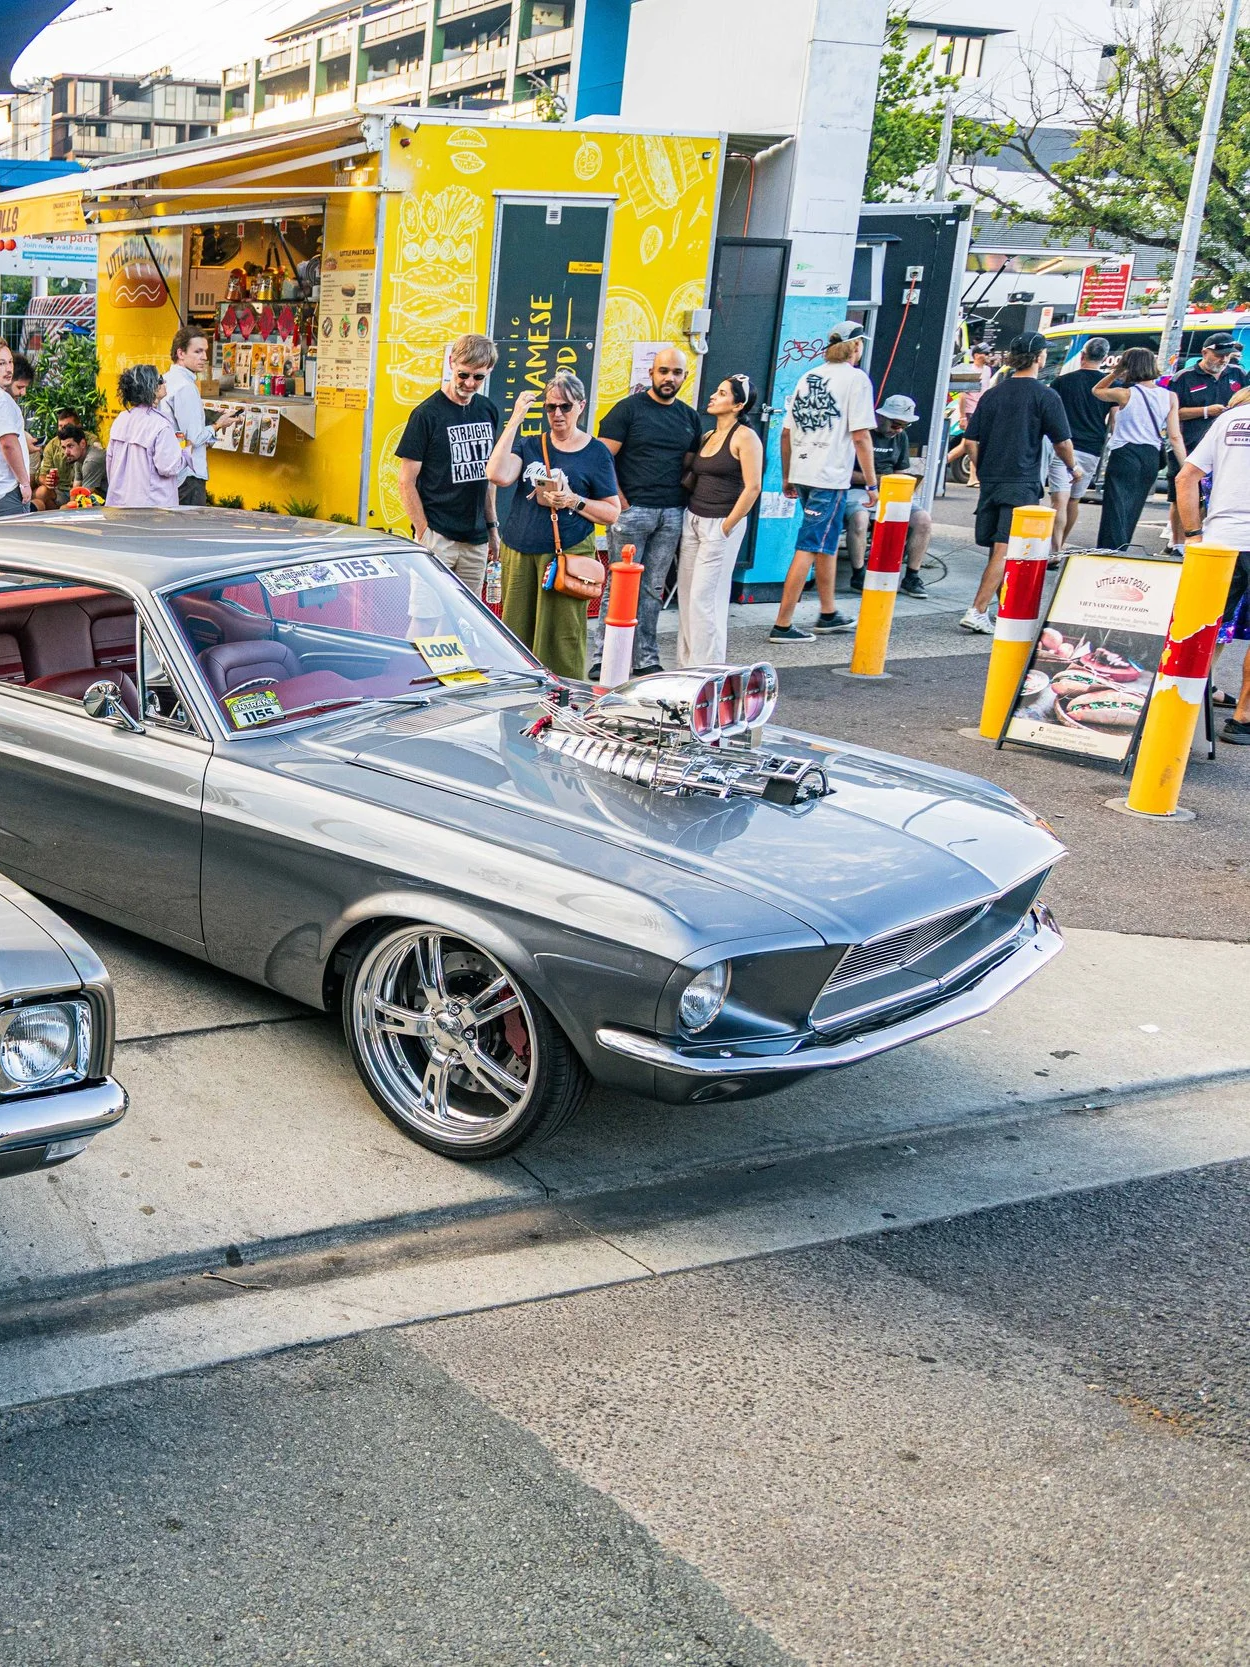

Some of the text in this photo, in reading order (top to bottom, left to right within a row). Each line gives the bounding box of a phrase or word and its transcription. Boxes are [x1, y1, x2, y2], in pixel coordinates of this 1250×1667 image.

[70, 234, 92, 243] part
[450, 424, 492, 442] STRAIGHT
[333, 559, 380, 579] 1155
[1095, 576, 1151, 593] LITTLE PHAT ROLLS
[421, 642, 464, 657] LOOK
[232, 698, 274, 712] ENTRANT
[242, 707, 275, 723] 1155
